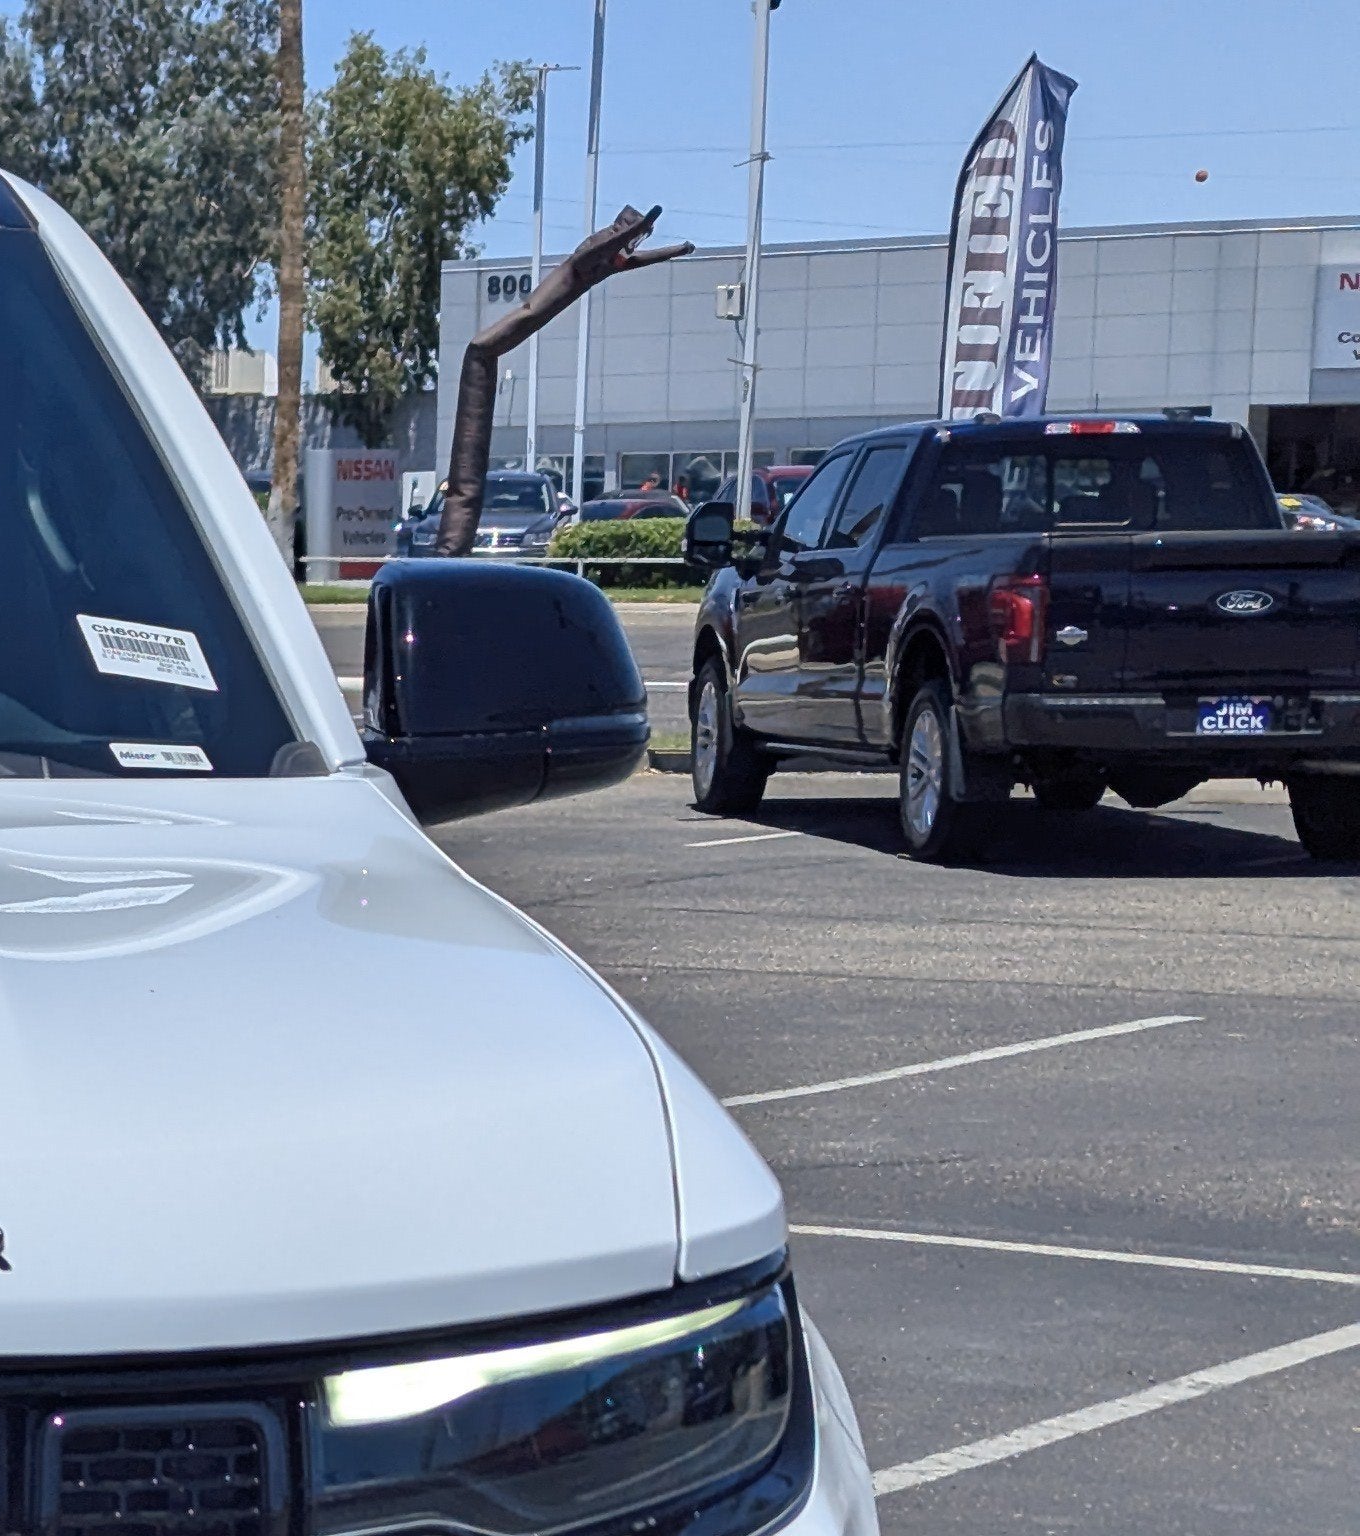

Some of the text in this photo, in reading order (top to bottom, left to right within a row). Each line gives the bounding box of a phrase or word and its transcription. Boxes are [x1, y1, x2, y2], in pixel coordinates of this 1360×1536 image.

[949, 118, 1019, 420] TIFIED
[1010, 119, 1055, 404] VEHICLES
[487, 273, 533, 296] 800
[336, 460, 395, 481] NISSAN
[1226, 593, 1264, 610] Ford
[1215, 703, 1253, 716] JIM
[1202, 715, 1264, 729] CLICK
